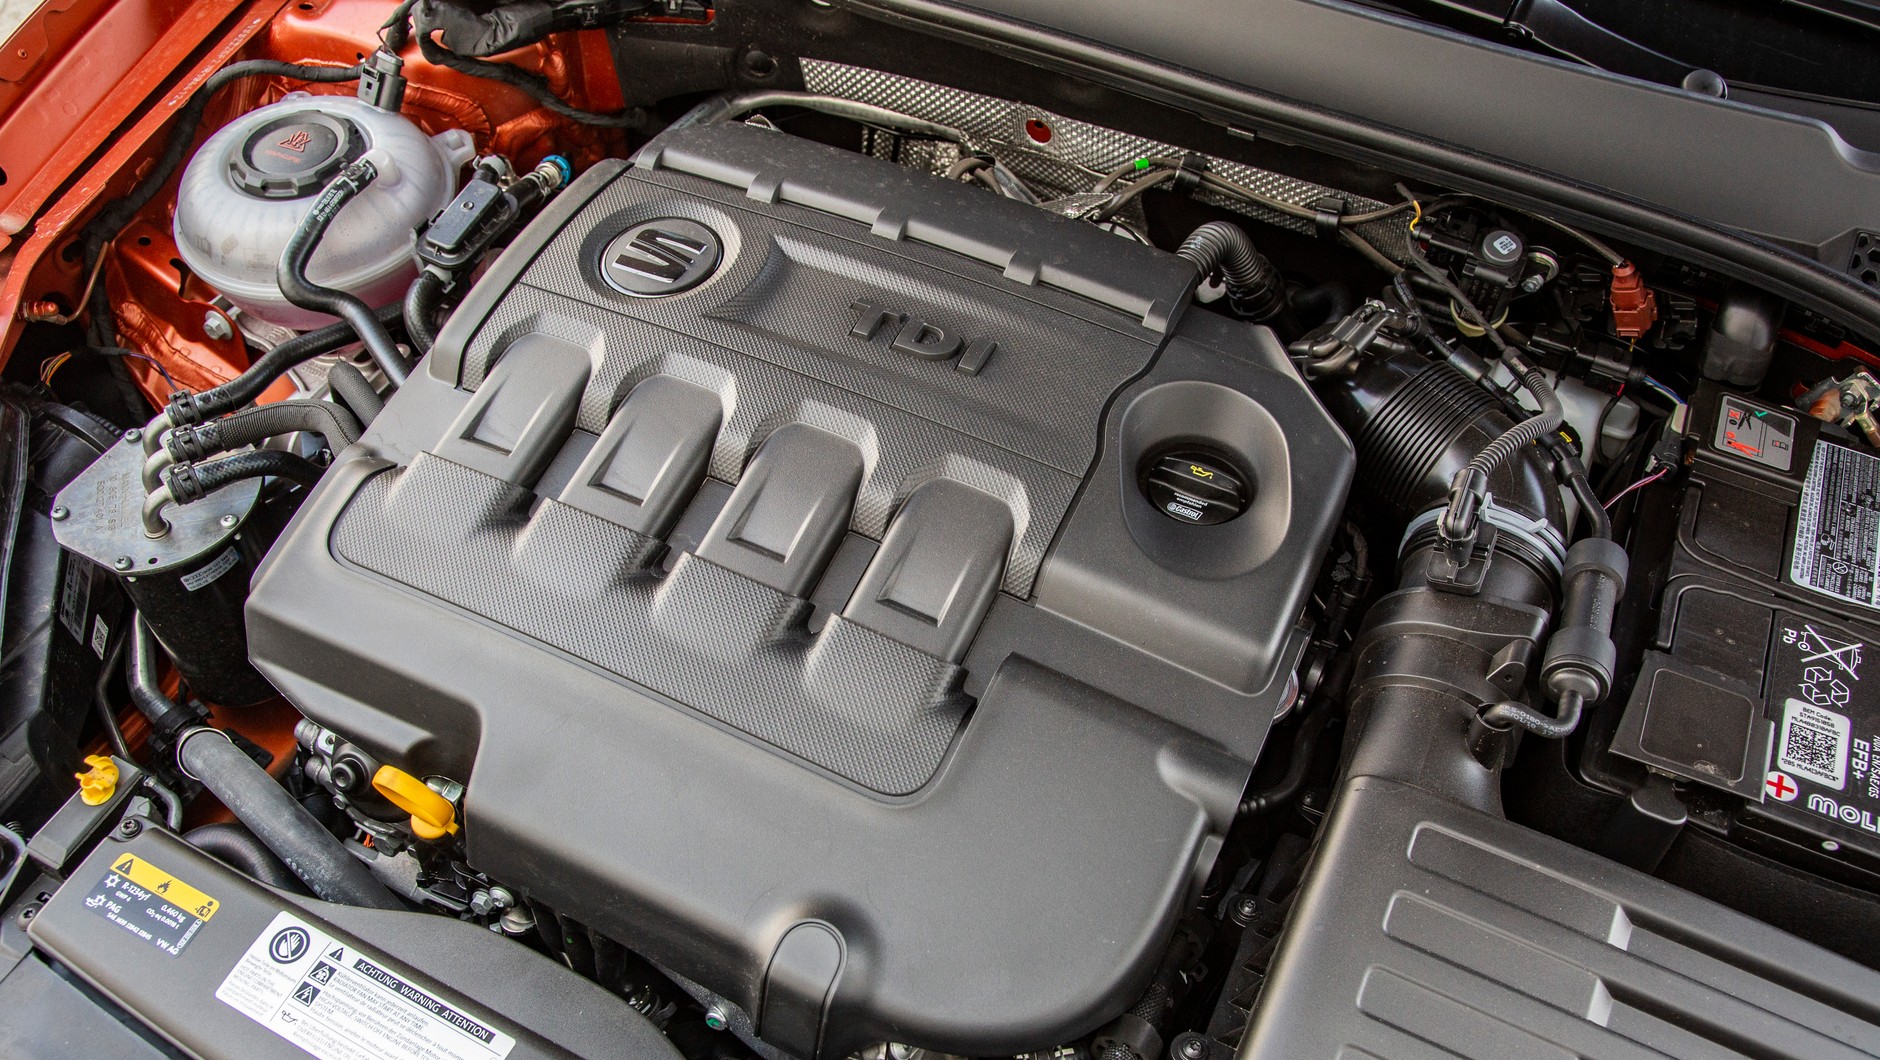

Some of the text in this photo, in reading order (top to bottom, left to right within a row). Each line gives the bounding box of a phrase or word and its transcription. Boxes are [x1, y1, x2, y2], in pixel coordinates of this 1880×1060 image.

[848, 298, 999, 377] TDI
[1175, 505, 1198, 517] Castrol
[1782, 627, 1797, 644] Pb
[1852, 738, 1870, 780] EFB+
[104, 900, 122, 913] PAG
[119, 880, 152, 903] R-1234yf
[175, 913, 186, 923] kg
[155, 938, 170, 950] VW
[167, 944, 179, 955] AG
[332, 976, 357, 992] RADIATOR
[356, 990, 367, 998] FAN
[366, 995, 379, 1005] MAY
[377, 1002, 393, 1013] START
[398, 1014, 411, 1023] ANY
[356, 961, 489, 1039] ACHTUNG WARNING ATTENTION
